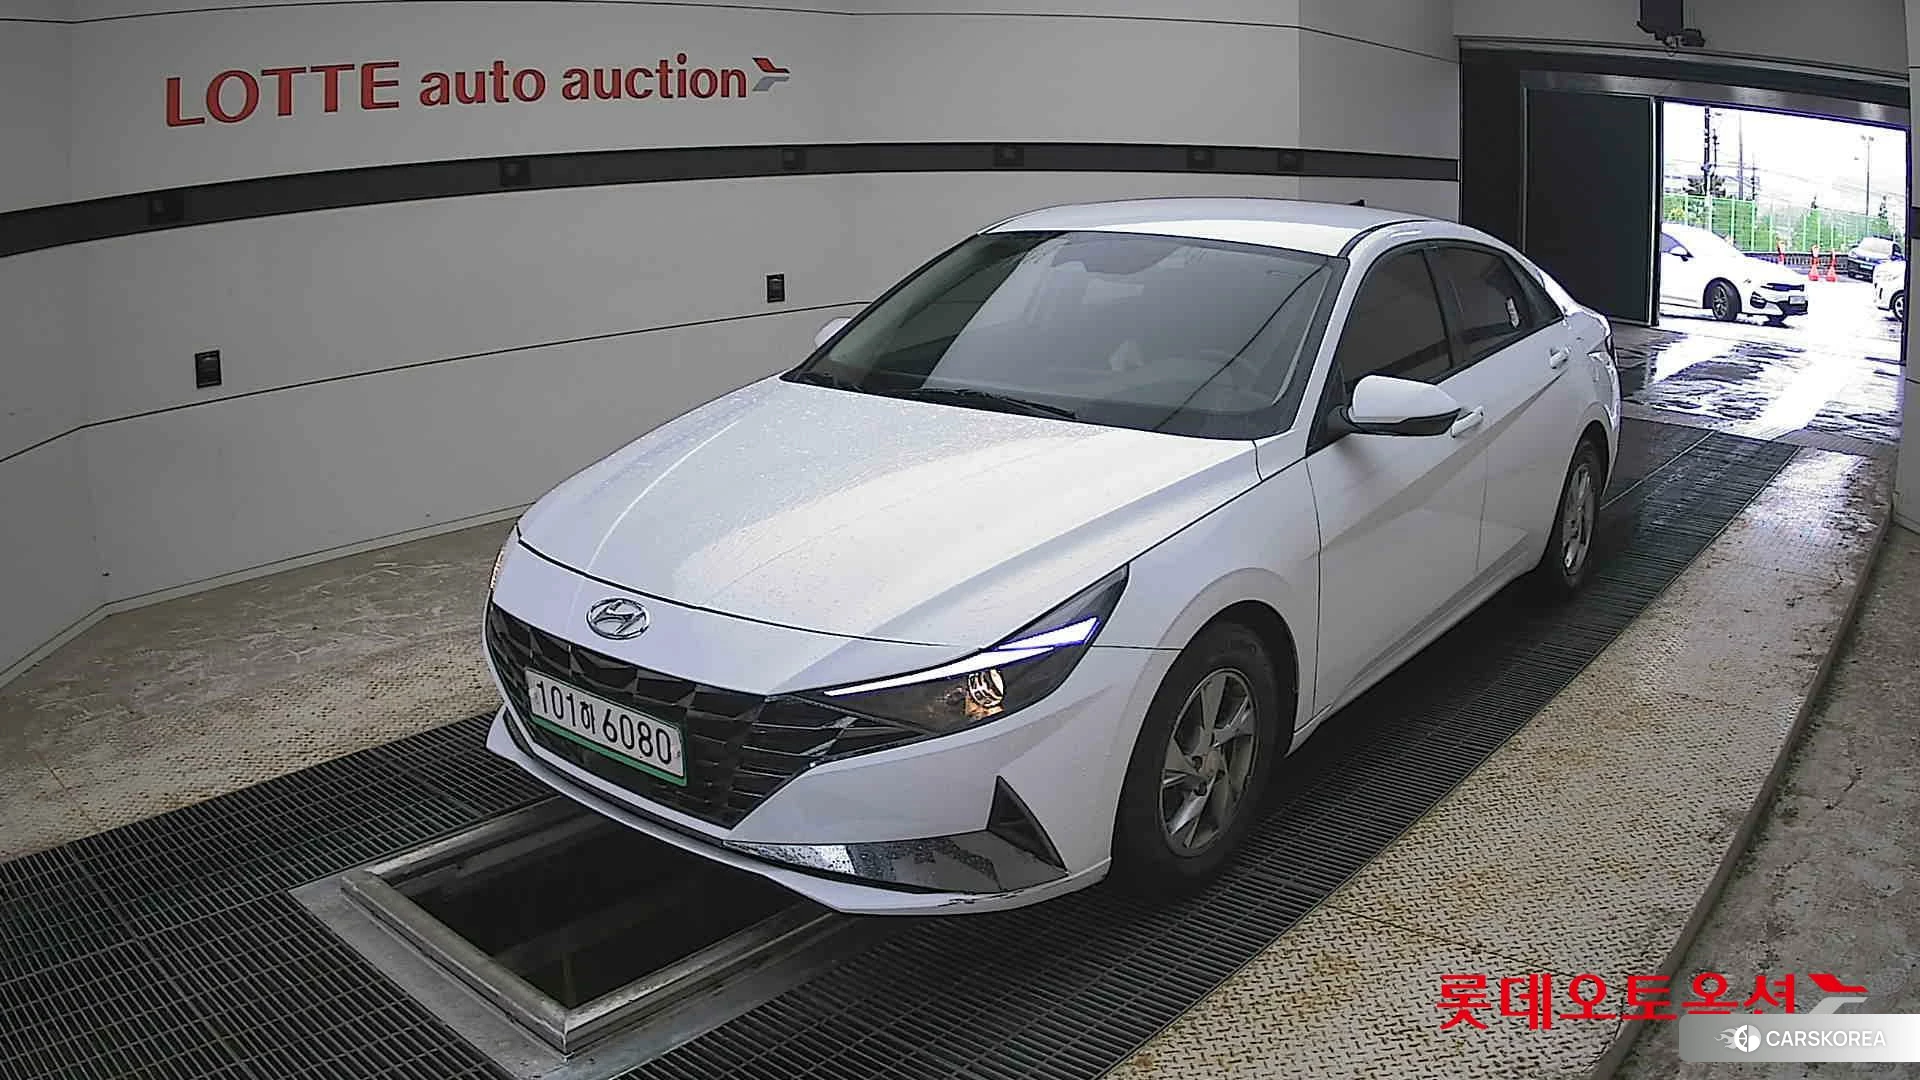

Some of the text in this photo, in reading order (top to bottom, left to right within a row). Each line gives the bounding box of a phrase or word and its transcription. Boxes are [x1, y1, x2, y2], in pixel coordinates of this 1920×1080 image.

[166, 53, 747, 127] LOTTE auto auction
